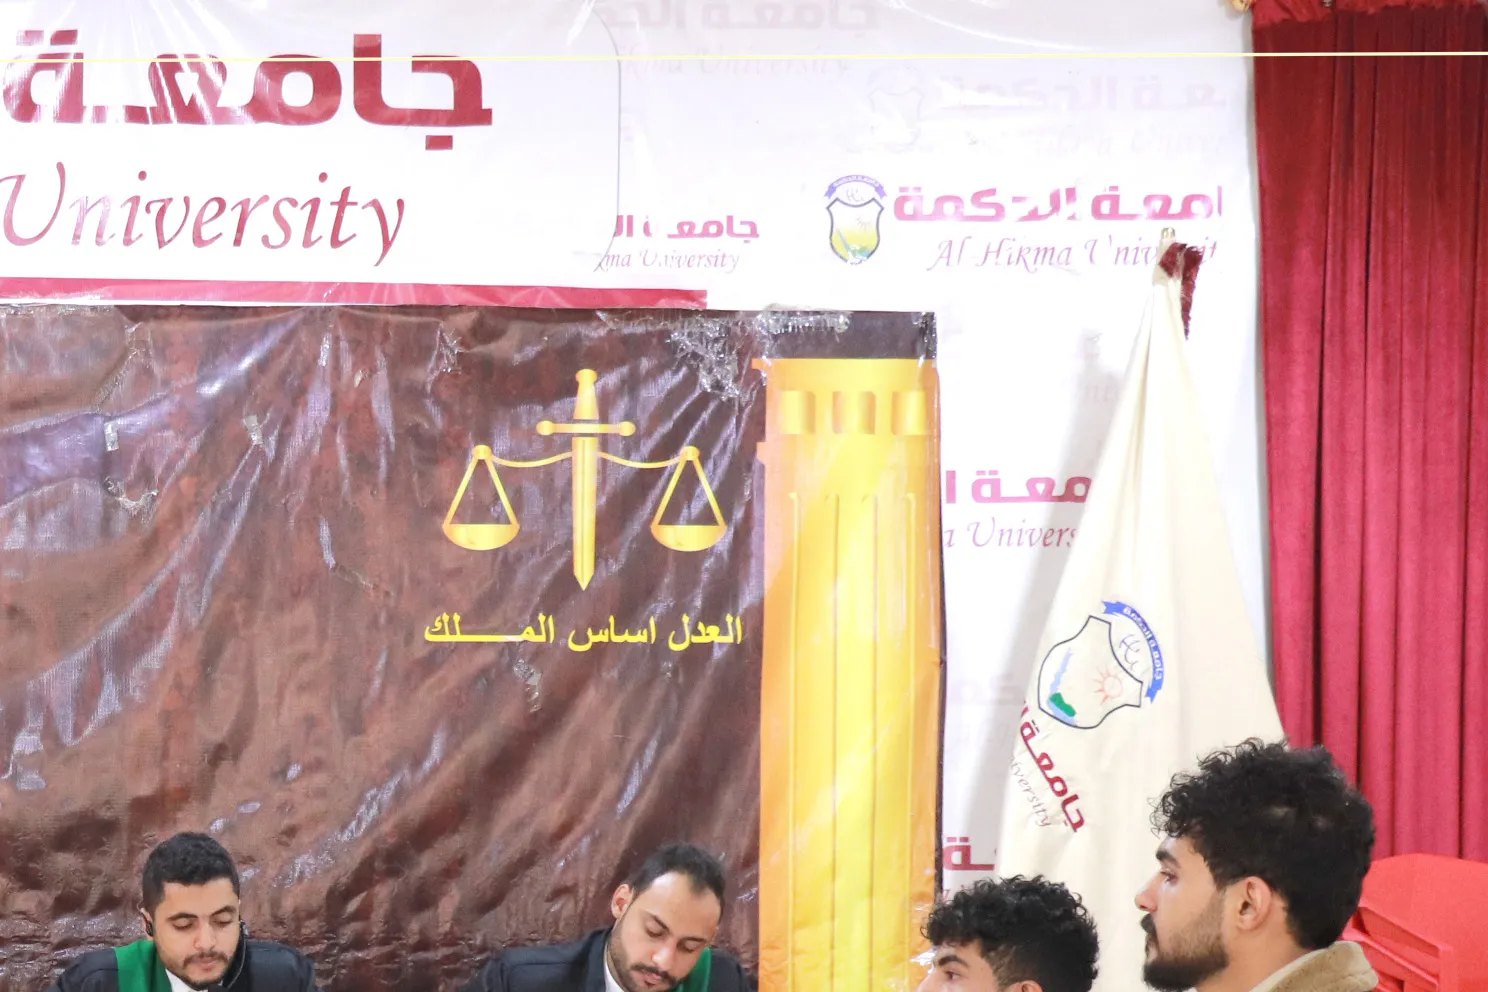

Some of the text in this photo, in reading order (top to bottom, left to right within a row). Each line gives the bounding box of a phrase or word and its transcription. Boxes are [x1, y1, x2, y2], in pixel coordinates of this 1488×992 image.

[2, 29, 493, 151] جامعة
[1090, 185, 1223, 222] امعة
[971, 469, 1093, 504] معة
[967, 516, 1077, 548] Univers
[567, 614, 657, 652] اساس
[668, 612, 742, 651] العدل
[1020, 718, 1086, 833] جامعة
